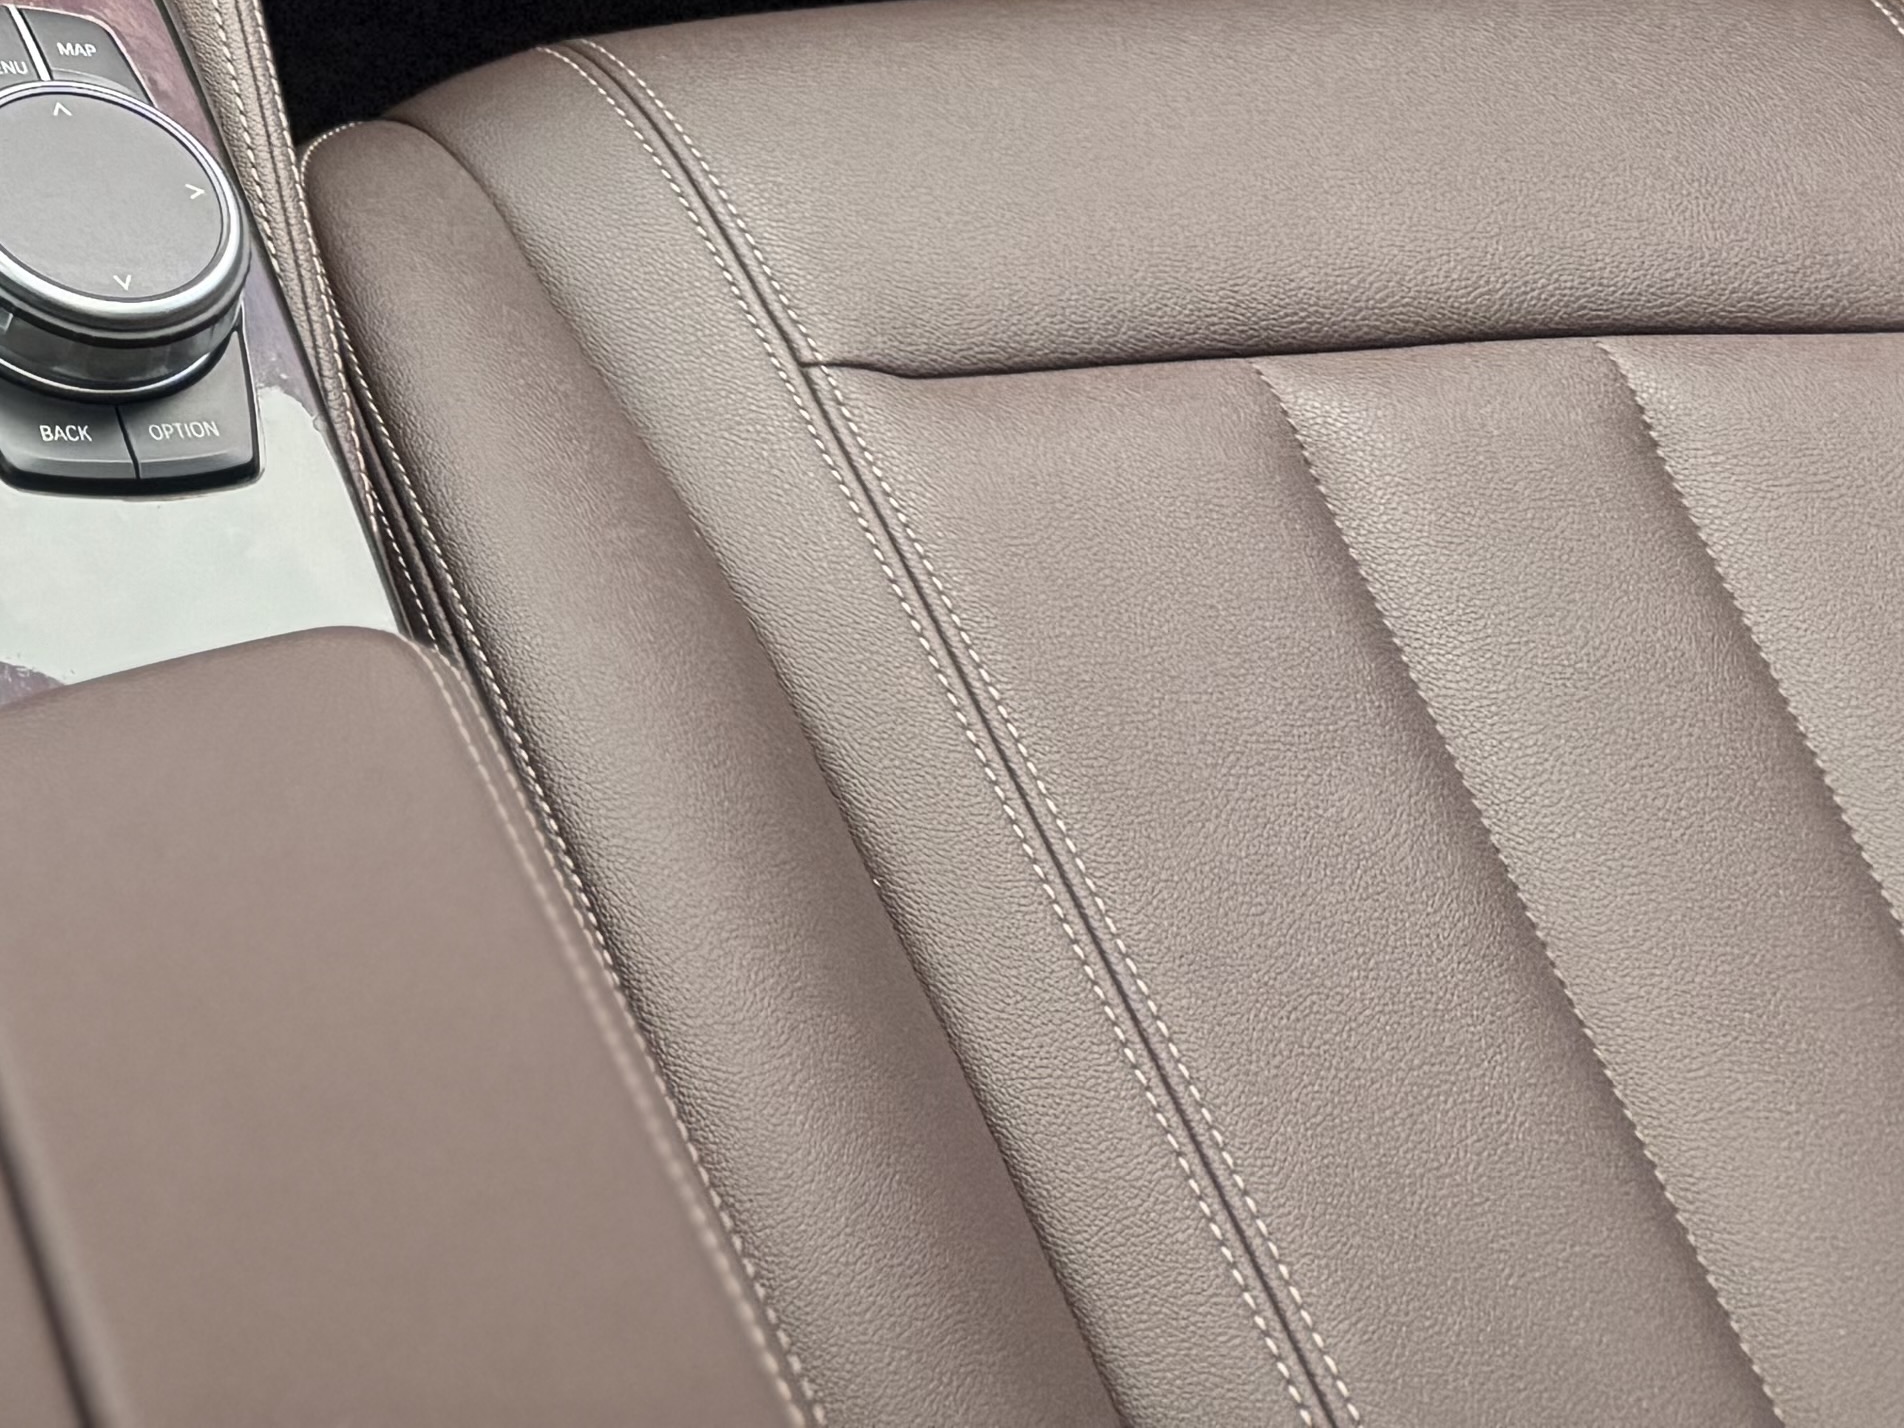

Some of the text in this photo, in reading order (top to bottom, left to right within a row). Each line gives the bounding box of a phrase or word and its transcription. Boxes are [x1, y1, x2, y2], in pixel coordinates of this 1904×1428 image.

[56, 41, 97, 59] MAP
[38, 425, 93, 443] BACK
[148, 420, 220, 440] OPTION
